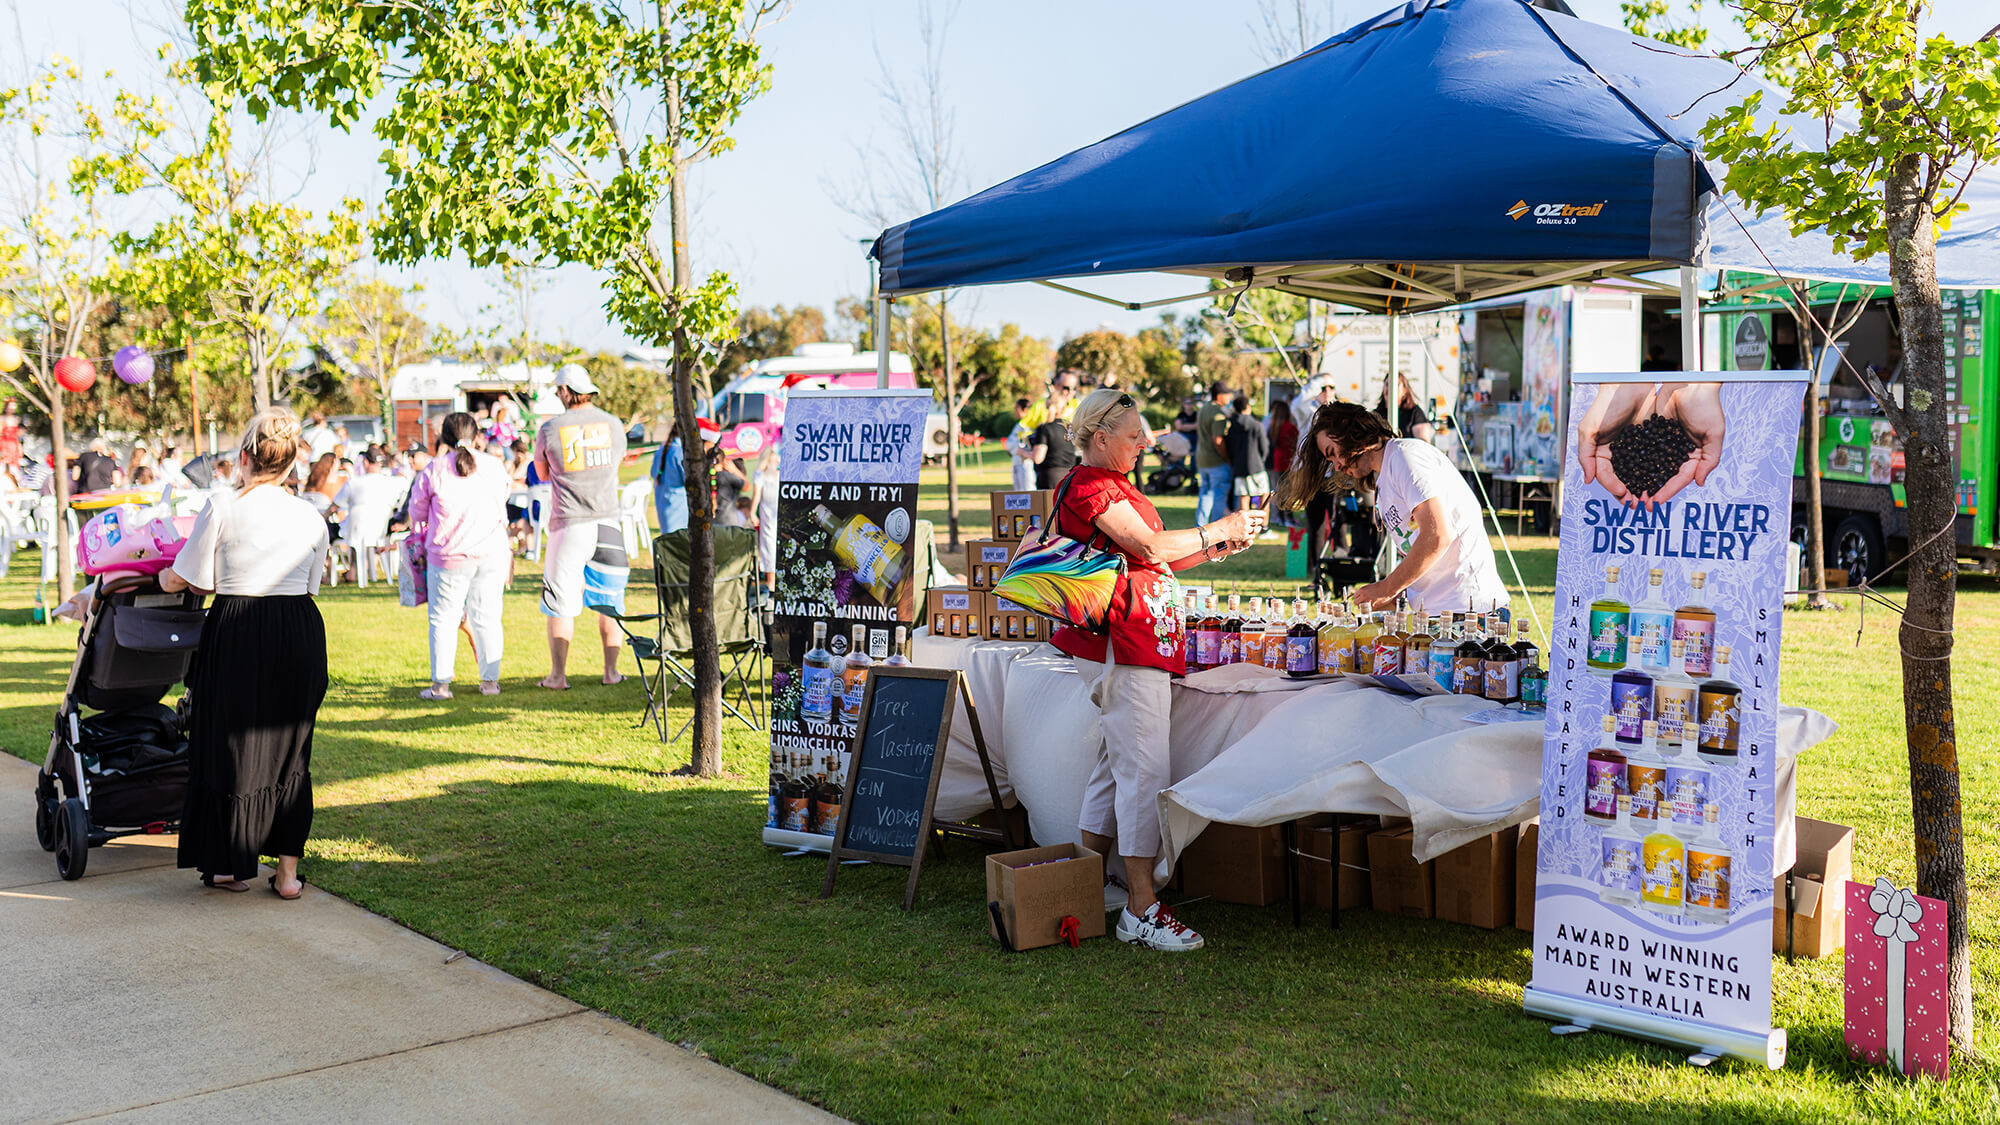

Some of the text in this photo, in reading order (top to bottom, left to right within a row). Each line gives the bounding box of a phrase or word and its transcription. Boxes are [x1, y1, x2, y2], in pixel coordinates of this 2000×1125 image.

[1533, 203, 1604, 217] OZtrail
[1536, 217, 1577, 225] Deluxe 3.0
[795, 424, 912, 444] SWAN RIVER
[801, 442, 905, 463] DISTILLERY
[781, 484, 822, 500] COME
[829, 485, 861, 502] AND
[1584, 500, 1770, 533] SWAN RIVER
[1593, 526, 1759, 561] DISTILLERY
[774, 601, 897, 622] AWARD WINNING
[871, 637, 887, 645] GIN
[1754, 608, 1767, 711] SMALL
[1557, 596, 1580, 818] HANDCRAFTED
[770, 734, 846, 752] LIMONCELLO
[873, 723, 934, 773] Tastings
[856, 778, 885, 798] GIN
[1746, 744, 1759, 847] BATCH
[877, 806, 920, 828] VODKA
[1557, 924, 1739, 974] AWARD WINNING
[1546, 944, 1750, 1001] MADE IN WESTERN
[1585, 979, 1705, 1018] AUSTRALIA
